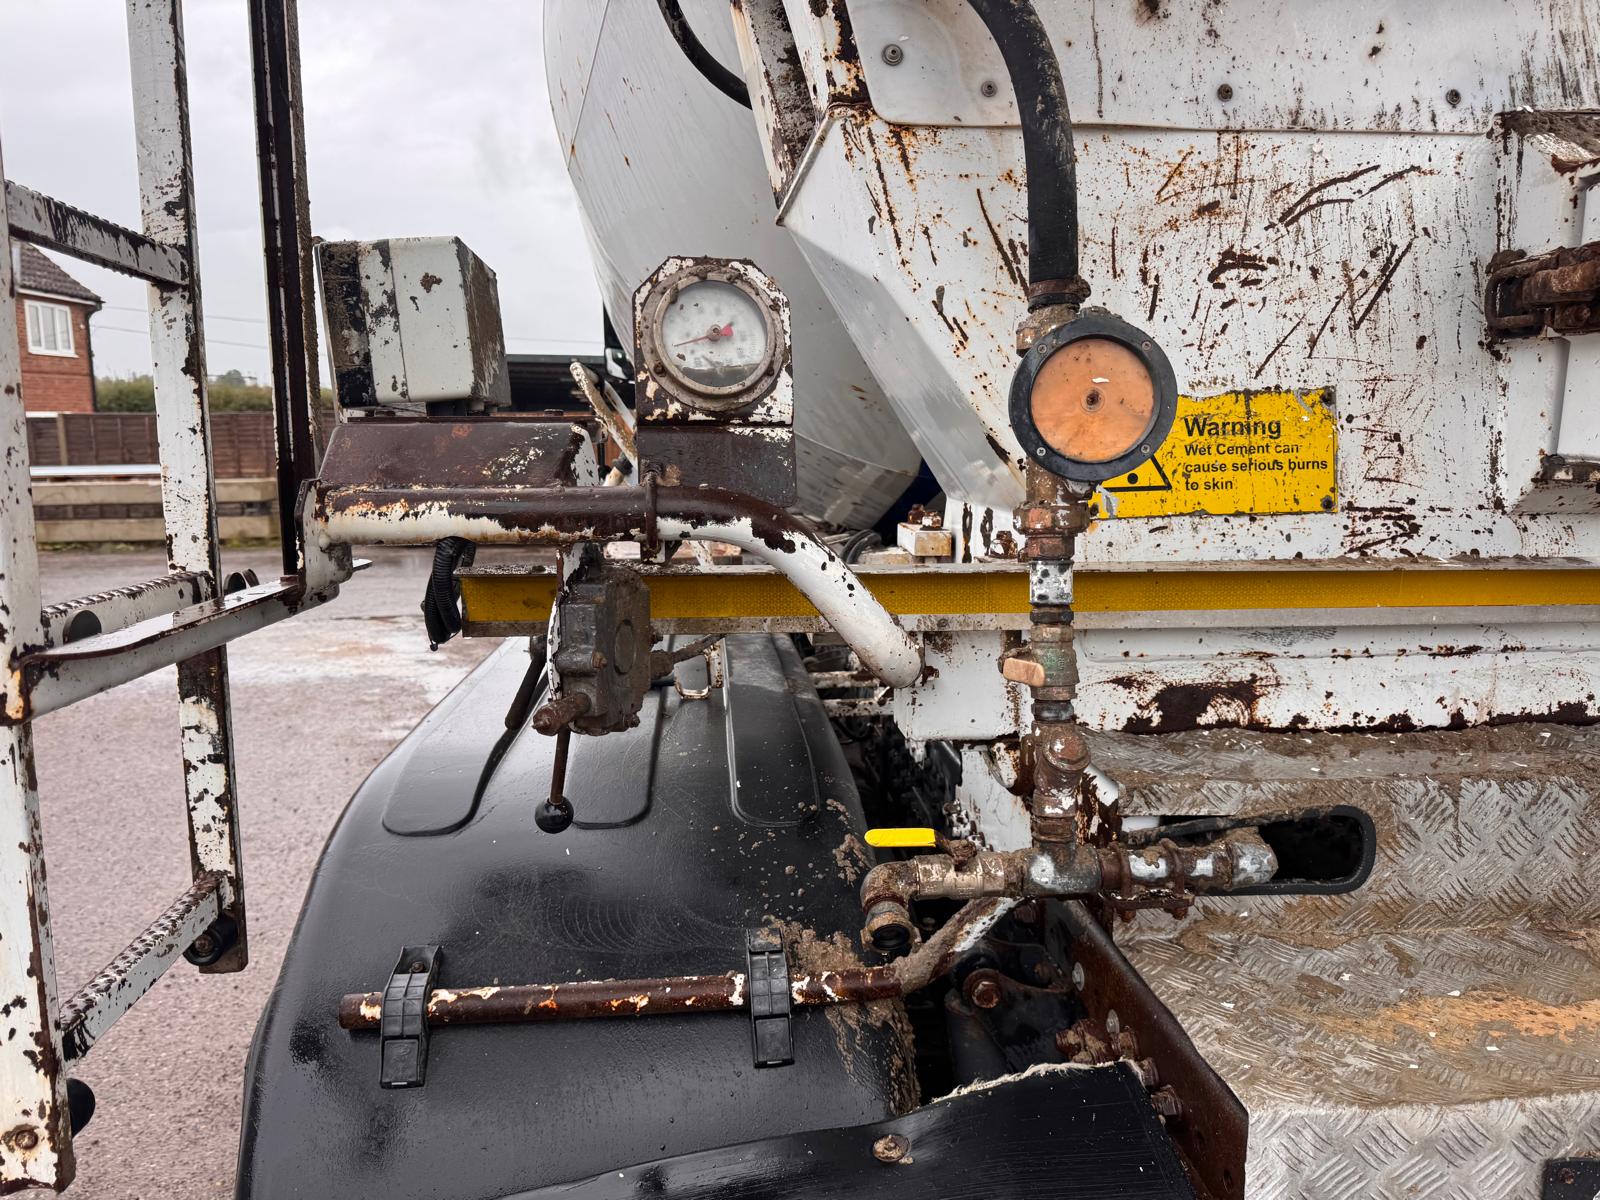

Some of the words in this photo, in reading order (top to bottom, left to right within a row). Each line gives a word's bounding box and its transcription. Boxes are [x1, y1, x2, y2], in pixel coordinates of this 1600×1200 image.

[1184, 415, 1281, 439] Warning
[1184, 444, 1212, 456] Wet
[1216, 443, 1270, 455] Cement
[1275, 444, 1300, 454] can
[1185, 463, 1227, 473] cause
[1231, 459, 1284, 472] serious
[1288, 459, 1328, 471] burns
[1185, 478, 1199, 491] to
[1204, 477, 1233, 491] skin
